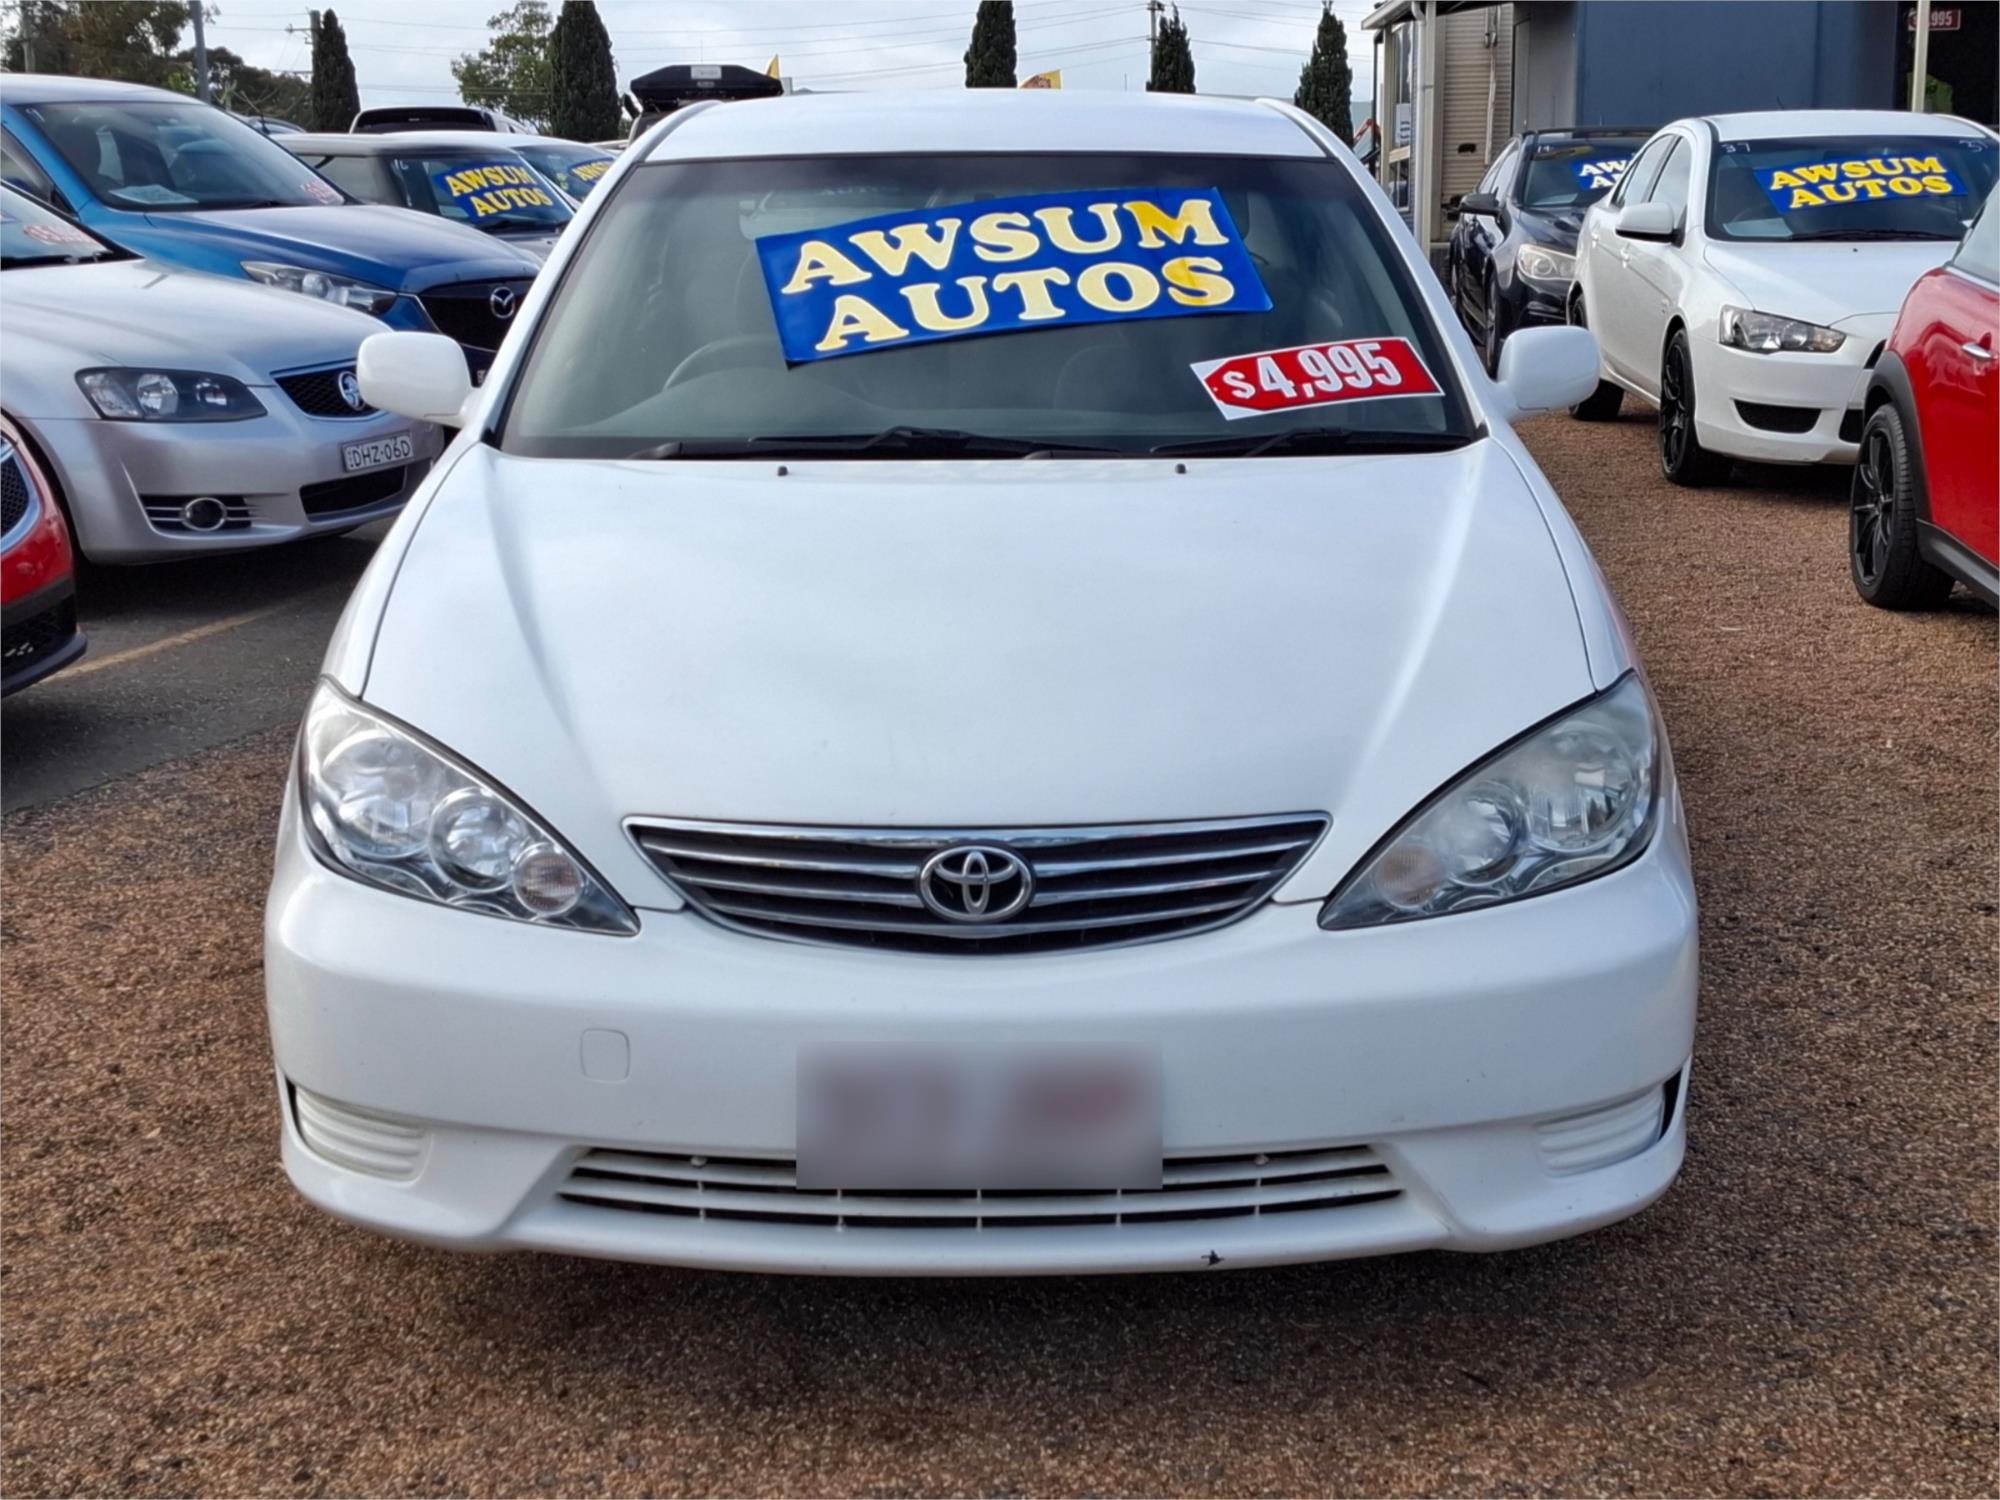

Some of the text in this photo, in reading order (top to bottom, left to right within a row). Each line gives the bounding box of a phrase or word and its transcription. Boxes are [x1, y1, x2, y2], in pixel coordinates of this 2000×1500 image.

[445, 165, 537, 196] AWSUM
[1770, 157, 1948, 190] AWSUM
[470, 187, 553, 217] AUTOS
[1790, 176, 1953, 209] AUTOS
[782, 199, 1230, 295] AWSUM
[815, 256, 1235, 352] AUTOS
[1223, 342, 1403, 399] $4,995
